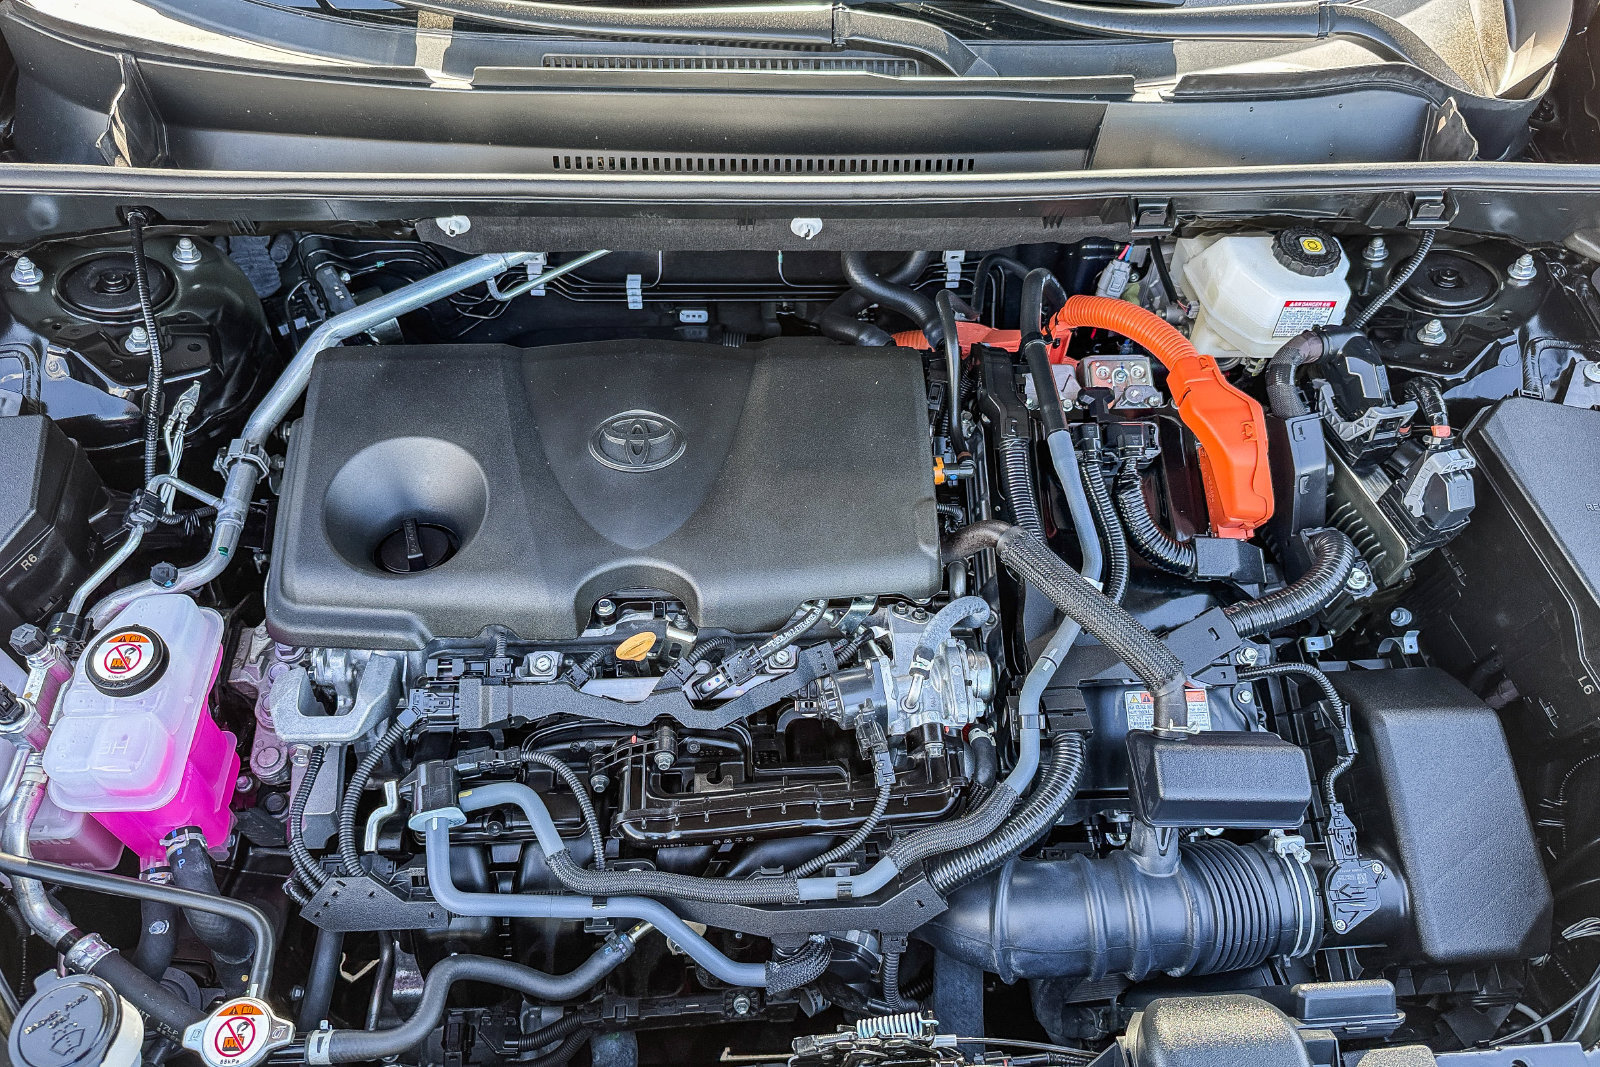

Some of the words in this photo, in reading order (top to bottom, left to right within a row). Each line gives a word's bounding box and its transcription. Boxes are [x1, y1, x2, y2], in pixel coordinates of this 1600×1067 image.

[1585, 503, 1600, 511] RE
[20, 553, 38, 571] R6
[1577, 675, 1595, 695] L6
